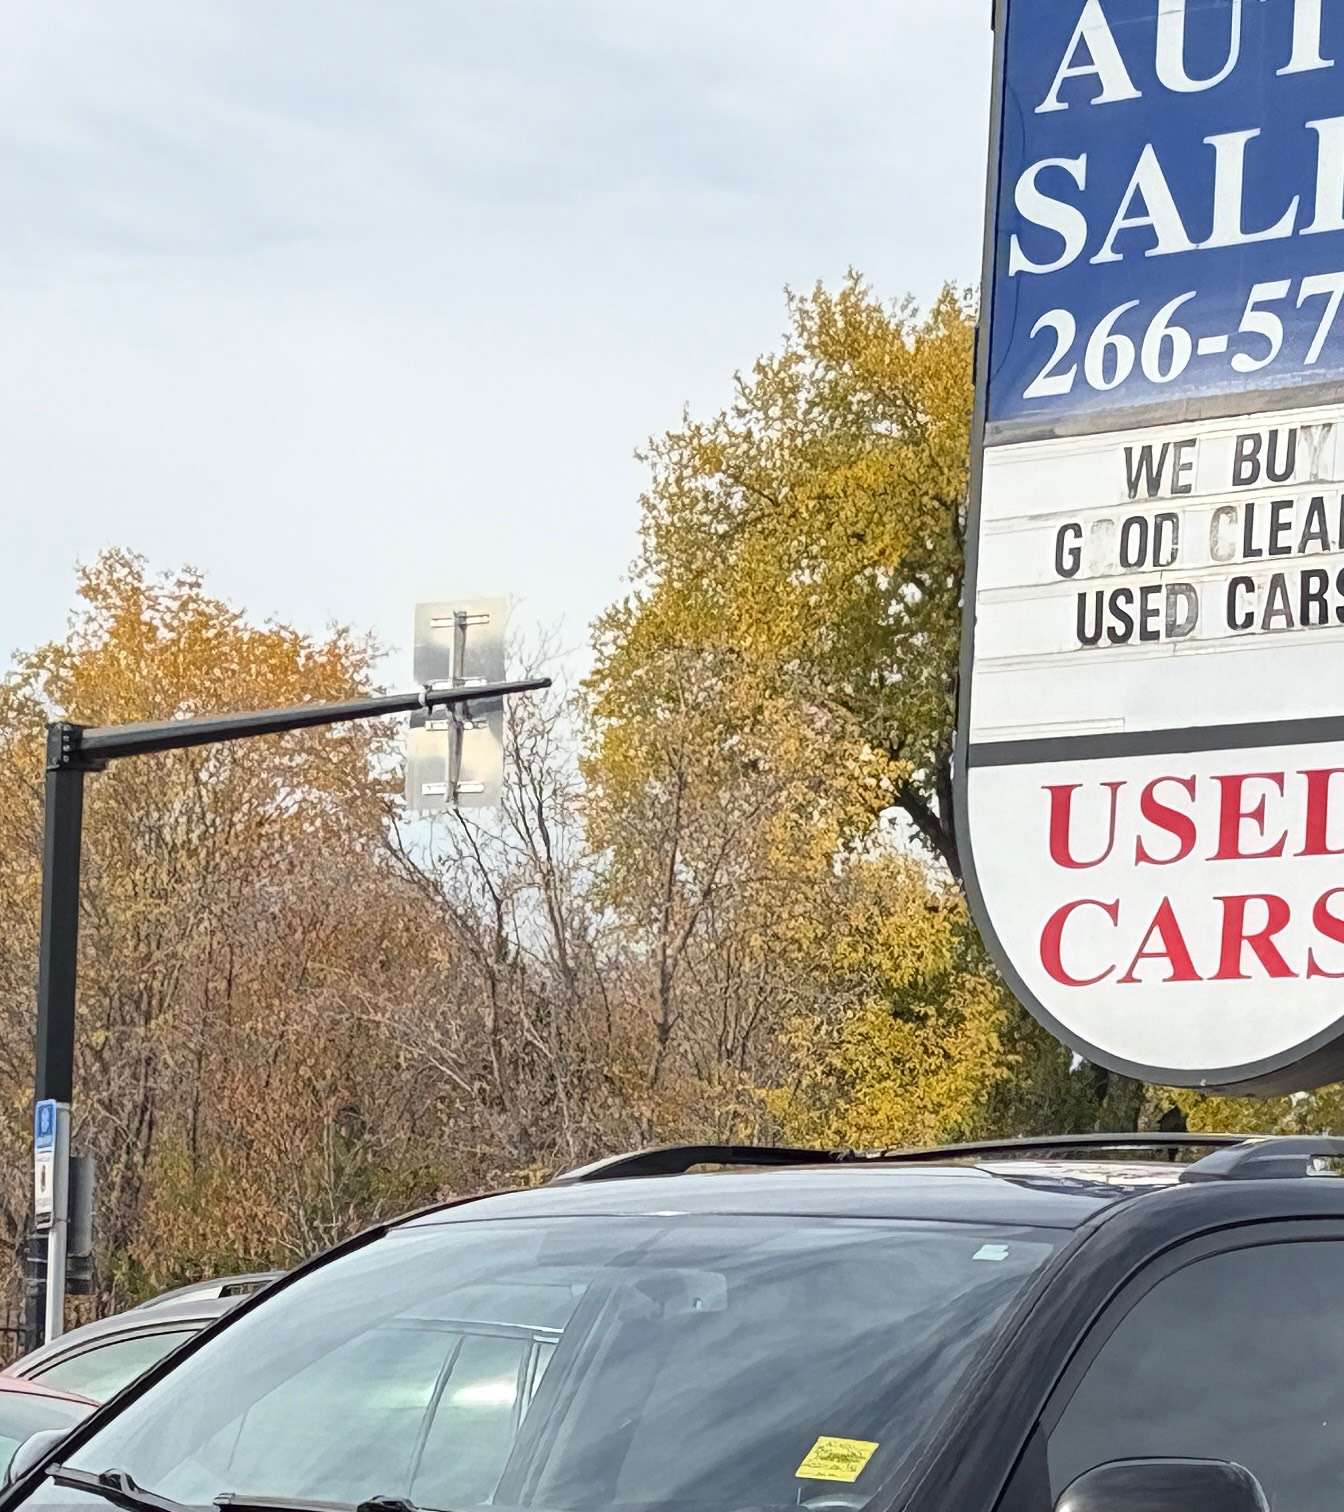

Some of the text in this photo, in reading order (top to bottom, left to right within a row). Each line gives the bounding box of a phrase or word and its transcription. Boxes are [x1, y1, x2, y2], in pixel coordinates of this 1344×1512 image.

[1123, 423, 1333, 499] WE BUY
[1055, 512, 1180, 579] GOD
[1076, 582, 1200, 646] USED
